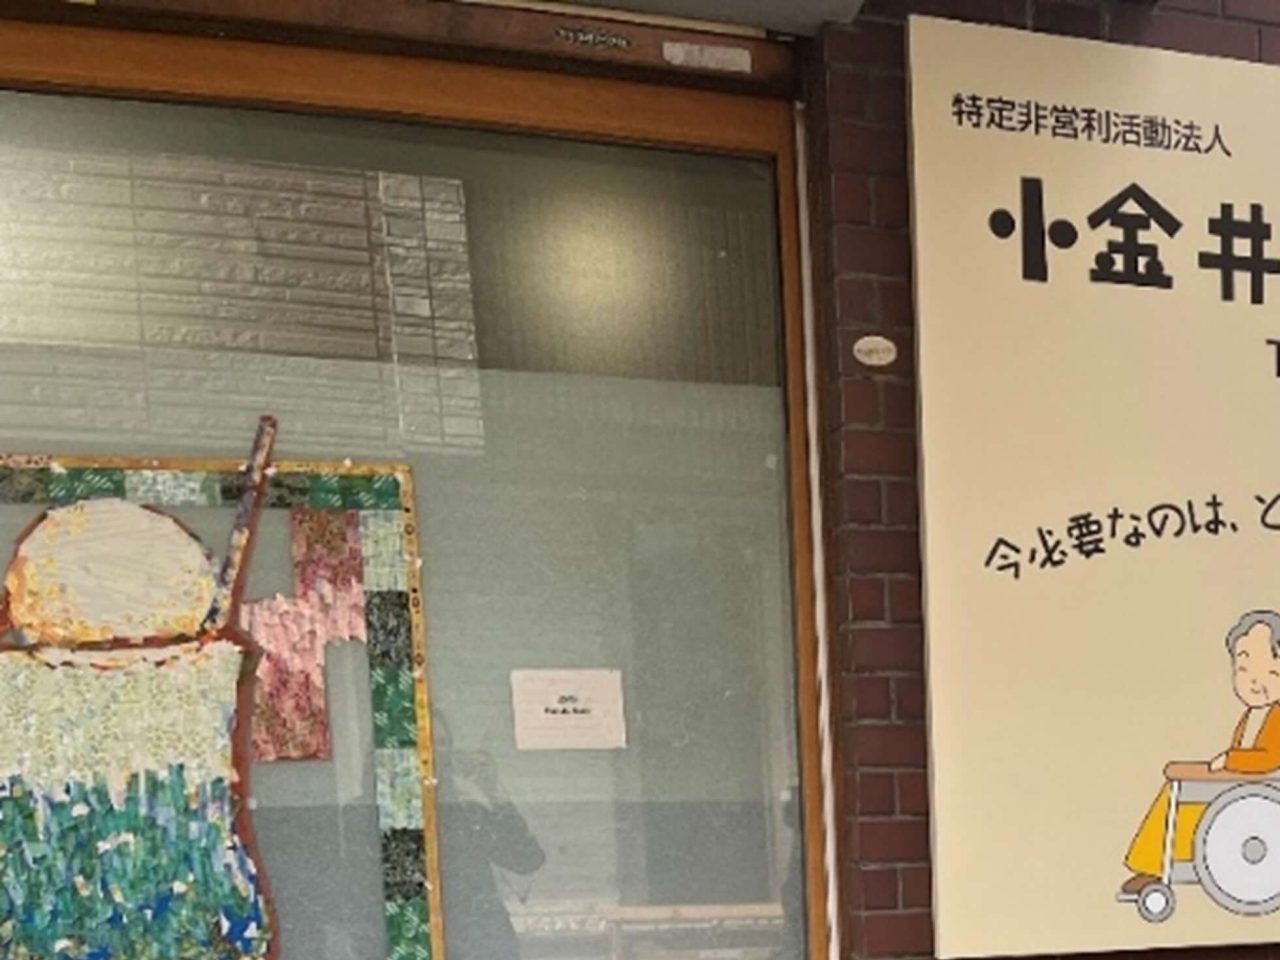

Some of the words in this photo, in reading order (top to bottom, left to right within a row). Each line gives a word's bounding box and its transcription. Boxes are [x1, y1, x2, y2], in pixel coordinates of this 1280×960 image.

[951, 92, 1232, 158] 特定非営利活動法人
